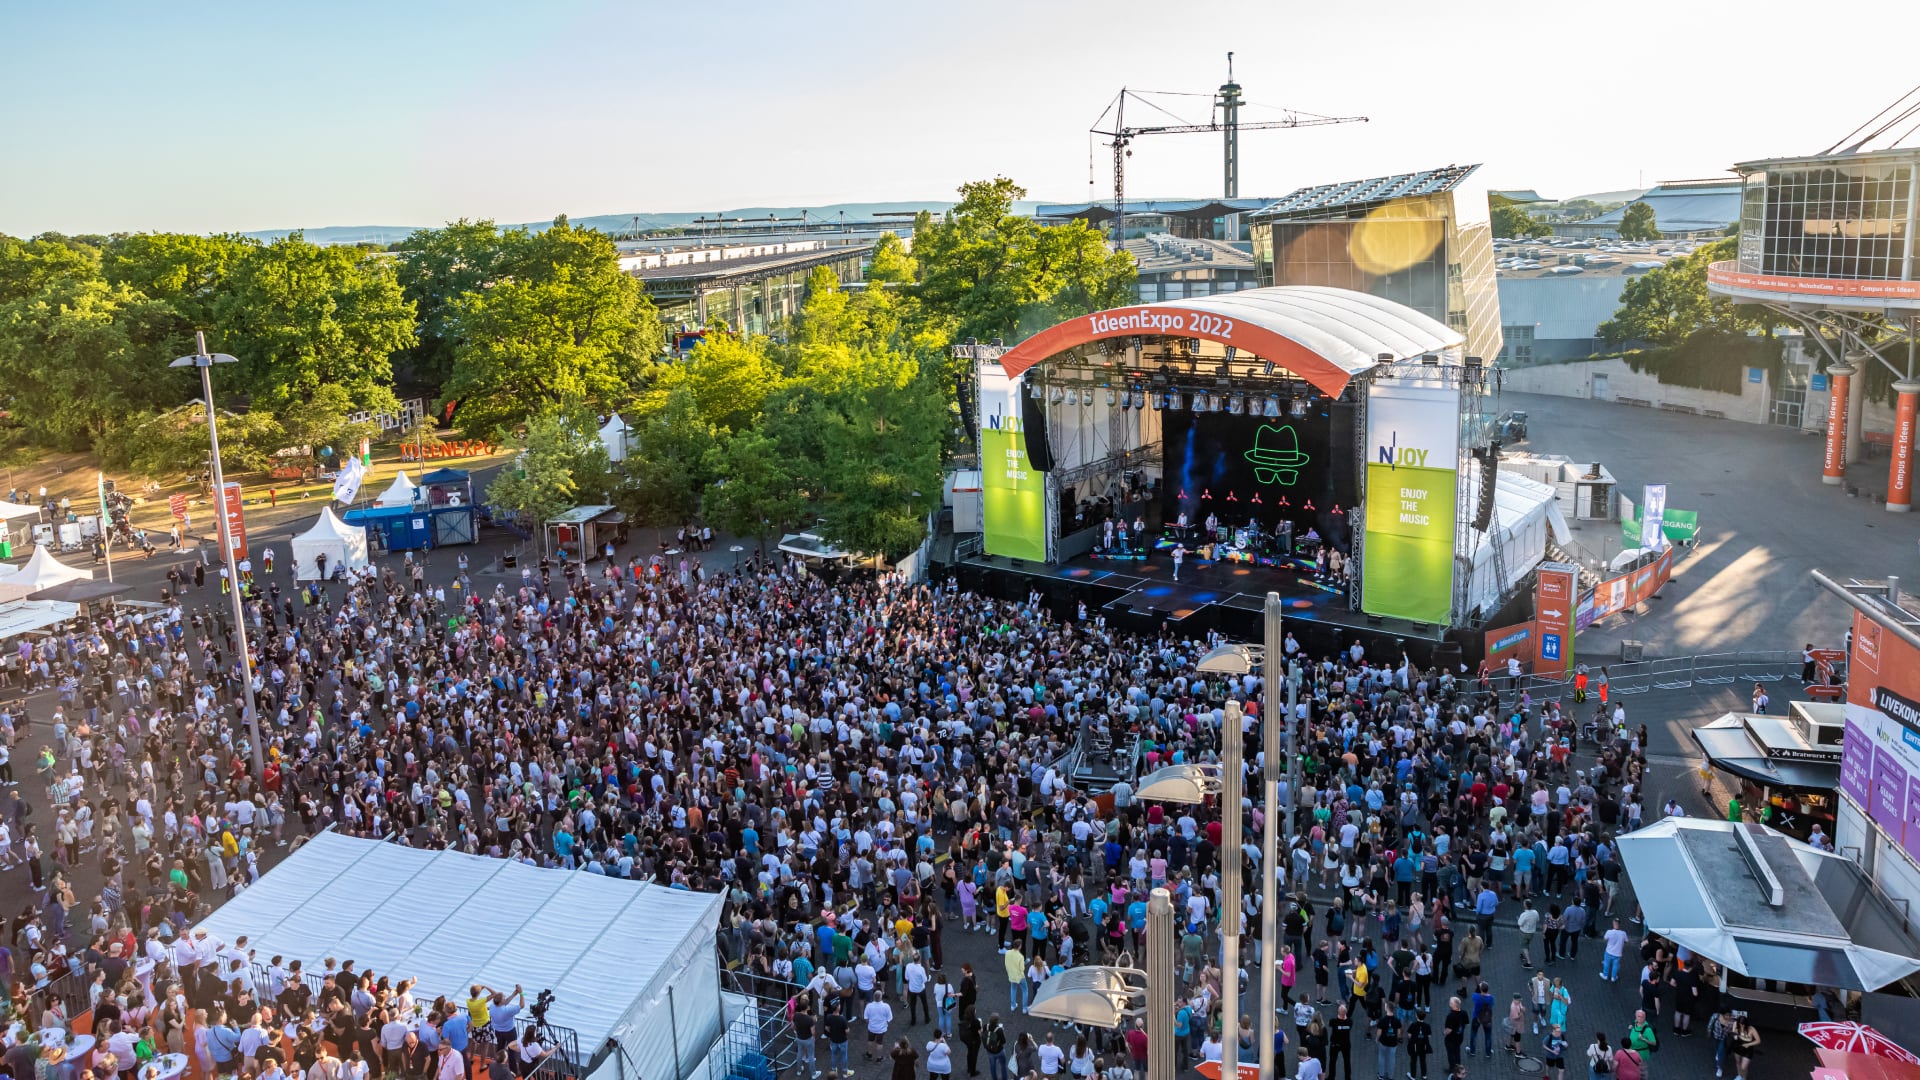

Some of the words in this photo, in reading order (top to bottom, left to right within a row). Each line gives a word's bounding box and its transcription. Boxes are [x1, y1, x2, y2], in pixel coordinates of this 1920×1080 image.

[1860, 285, 1883, 293] Campus
[1896, 286, 1916, 294] Ideen
[1089, 310, 1184, 334] IdeenExpo
[1189, 313, 1233, 339] 2022
[1824, 438, 1834, 469] Campus
[1829, 396, 1837, 420] Ideen
[1899, 421, 1909, 444] Ideen
[1898, 445, 1907, 458] der
[1007, 459, 1019, 469] THE
[1894, 460, 1905, 490] Campus
[1400, 487, 1428, 500] ENJOY
[1401, 500, 1418, 512] THE
[1400, 512, 1430, 526] MUSIC
[1792, 751, 1826, 759] Bratwurst
